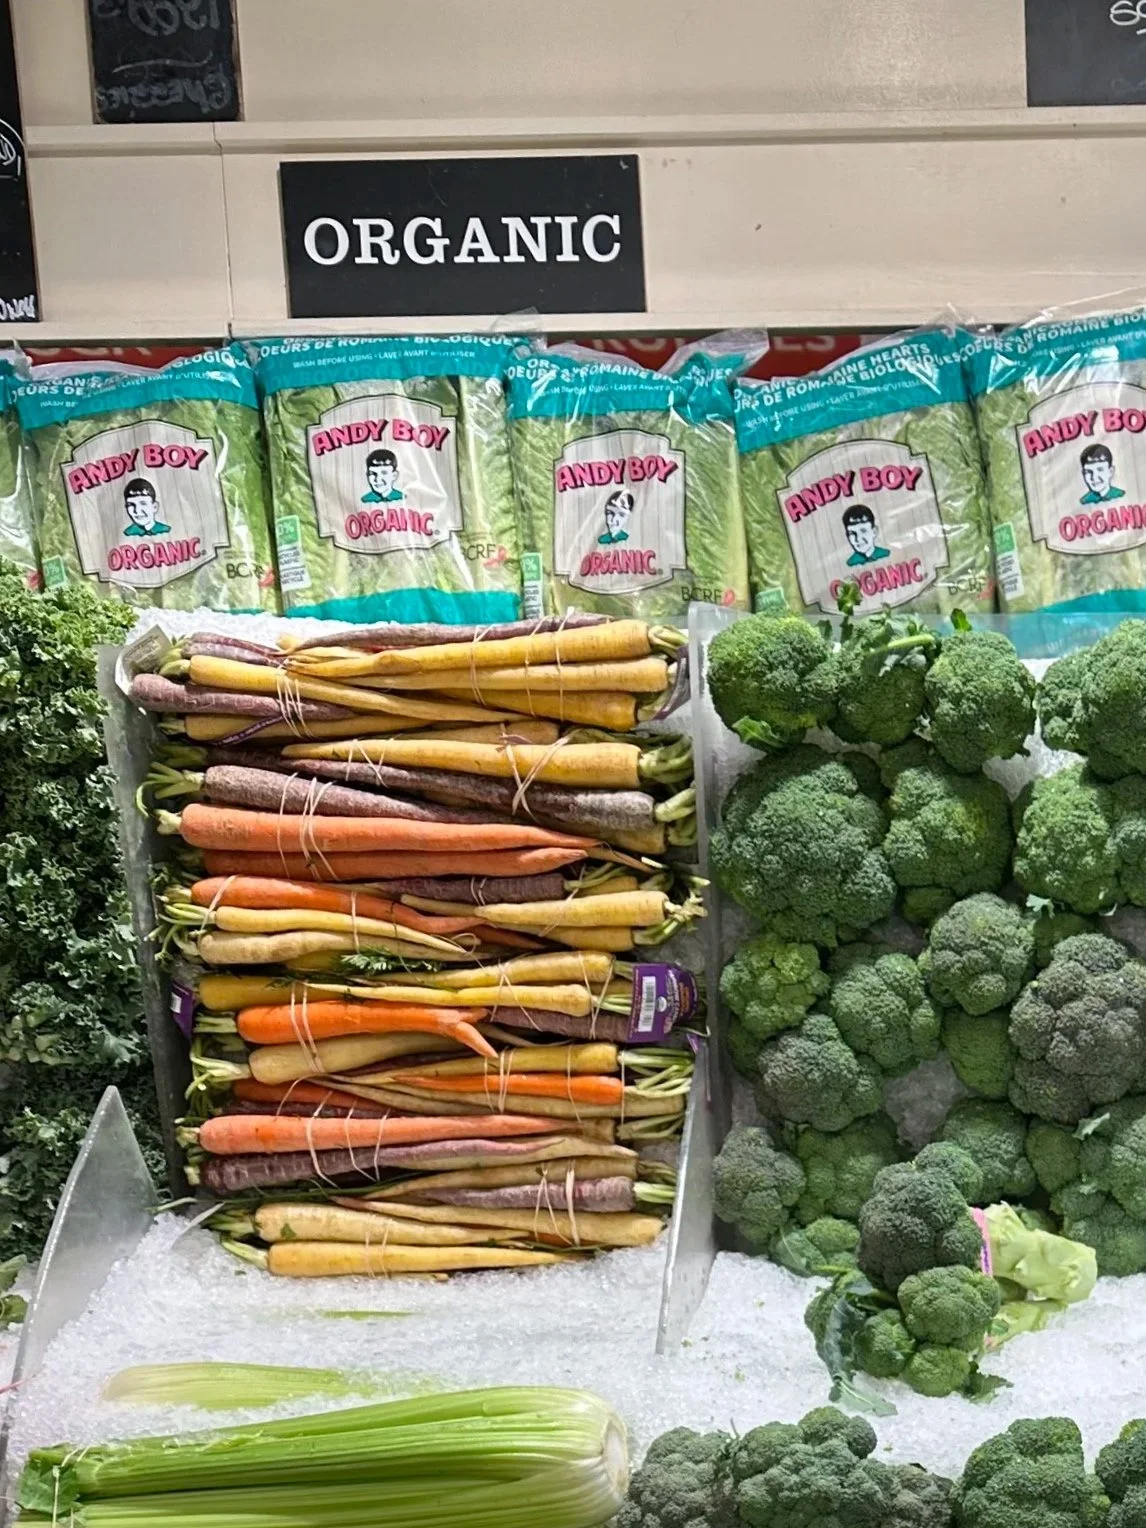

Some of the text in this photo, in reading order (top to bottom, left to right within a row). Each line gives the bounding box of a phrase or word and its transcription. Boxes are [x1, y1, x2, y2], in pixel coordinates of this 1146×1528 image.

[303, 214, 622, 265] ORGANIC
[404, 350, 430, 360] AVANT
[869, 342, 931, 366] HEARTS
[763, 391, 784, 406] DE
[313, 418, 450, 457] ANDY BOY
[1023, 411, 1098, 457] ANDY
[68, 444, 208, 494] ANDY BOY
[557, 454, 679, 492] ANDY BOY
[784, 464, 923, 523] ANDY BOY
[344, 508, 434, 540] ORGANIC
[108, 538, 201, 572] ORGANIC
[581, 550, 657, 577] ORGANIC
[830, 557, 925, 601] OGANIC
